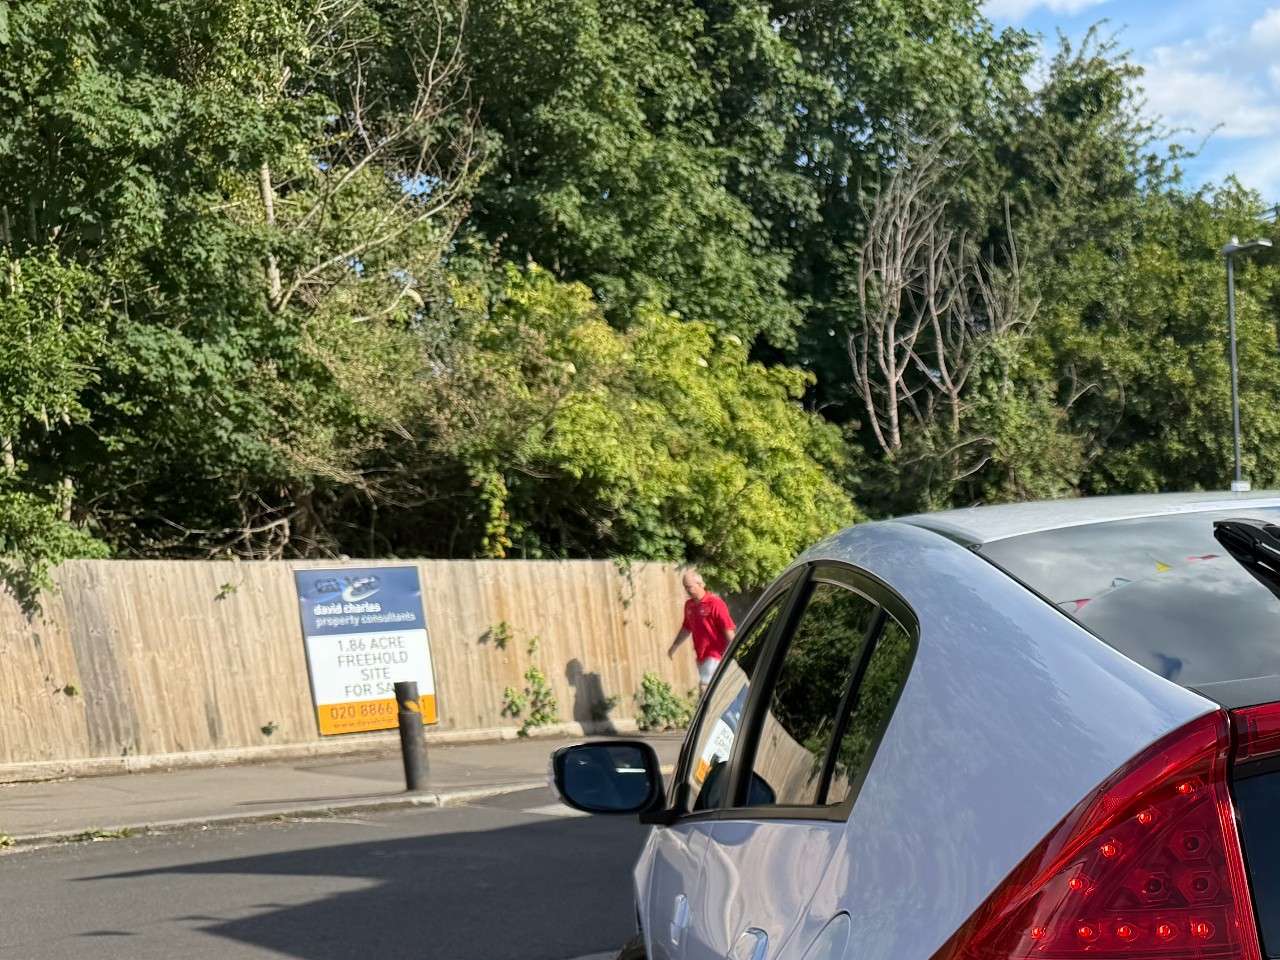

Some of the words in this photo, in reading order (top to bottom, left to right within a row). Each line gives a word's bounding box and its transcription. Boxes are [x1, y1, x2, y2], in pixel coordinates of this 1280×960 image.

[313, 603, 343, 616] david
[343, 601, 382, 614] charles
[315, 614, 360, 628] property
[360, 611, 416, 625] consultants
[337, 639, 366, 652] 1.86
[370, 636, 407, 650] ACRE
[337, 651, 409, 668] FREEHOLD
[360, 667, 391, 680] SITE
[345, 683, 372, 697] FOR
[375, 682, 398, 695] SA
[330, 705, 357, 720] 020
